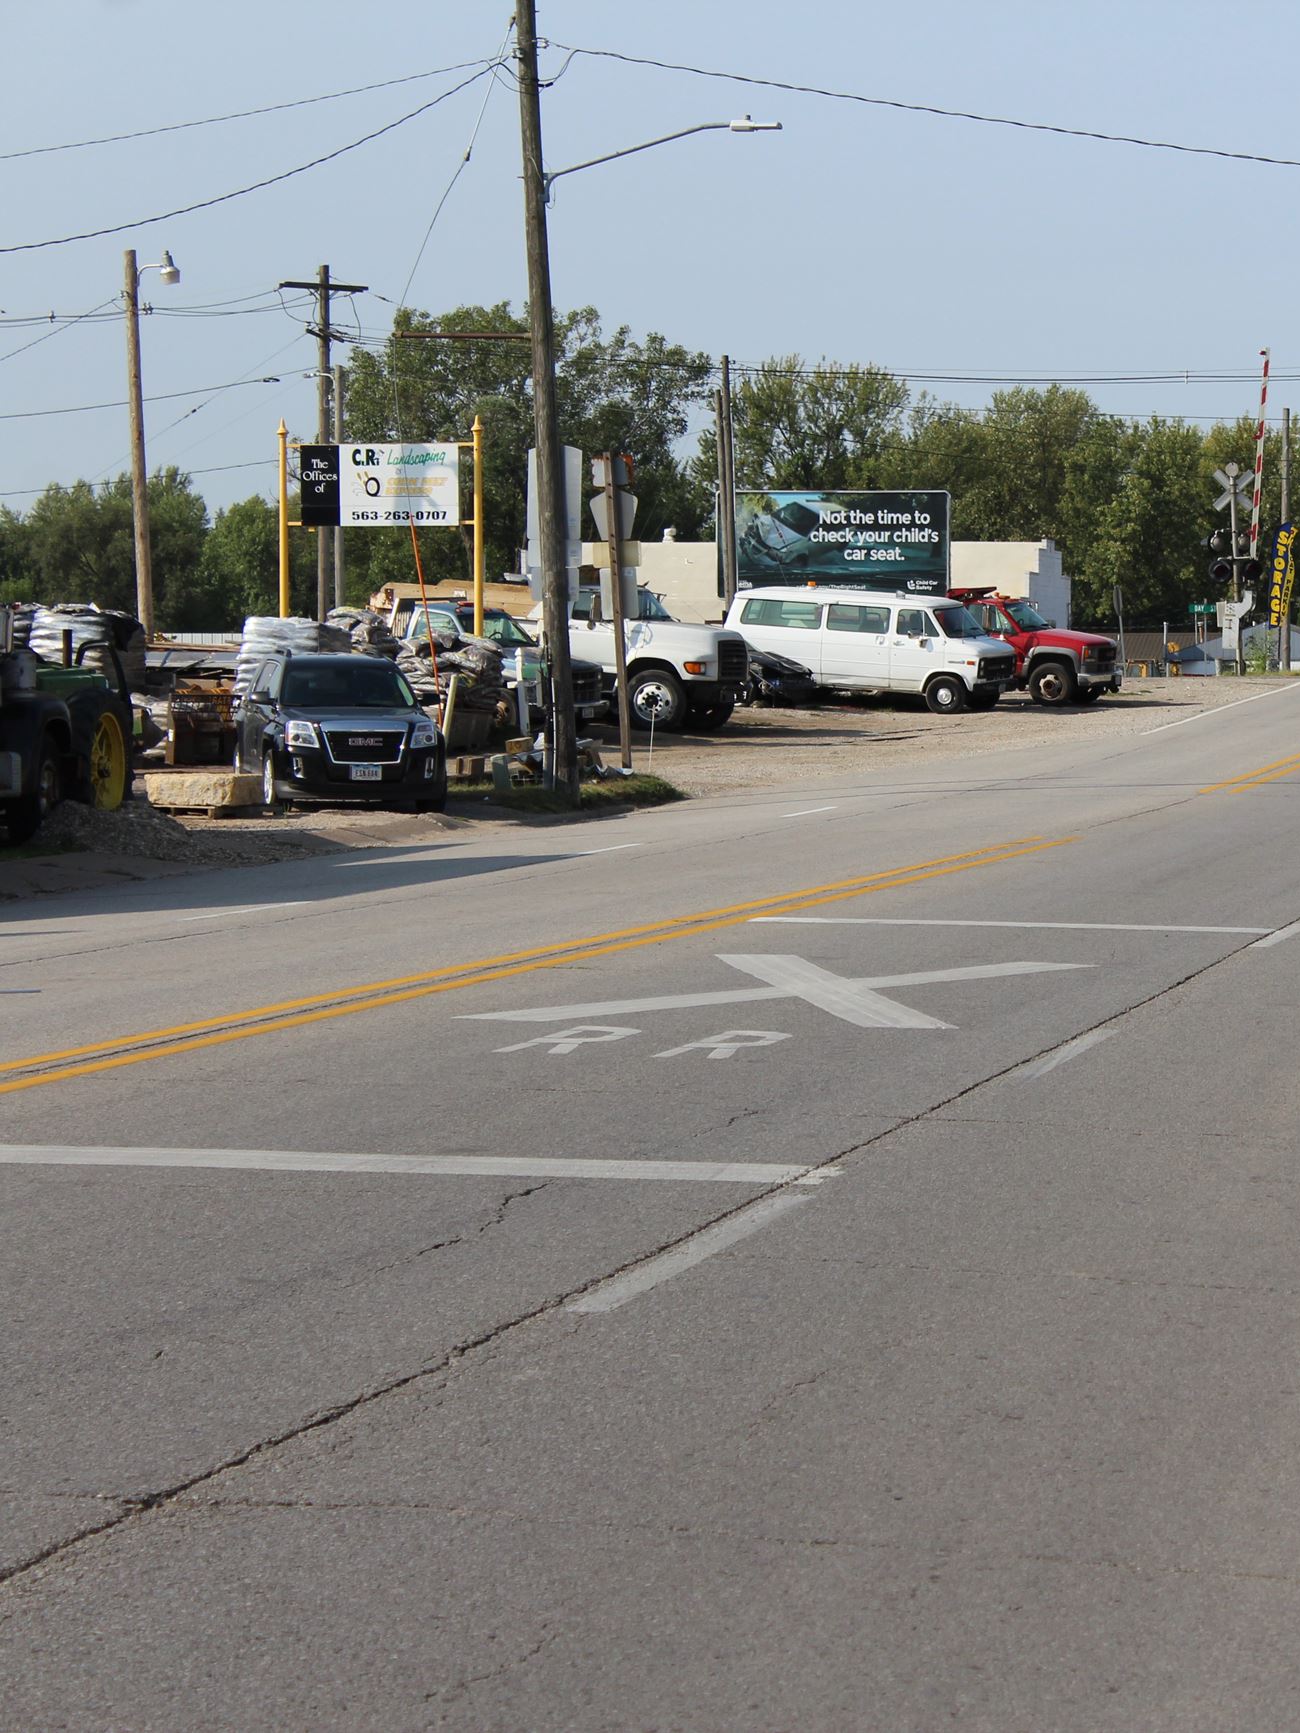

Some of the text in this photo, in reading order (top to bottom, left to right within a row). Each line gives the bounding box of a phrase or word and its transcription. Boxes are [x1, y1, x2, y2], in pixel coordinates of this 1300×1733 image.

[387, 448, 446, 466] Landscaping
[311, 459, 328, 469] The
[303, 471, 338, 481] Offices
[314, 483, 326, 493] of
[352, 511, 447, 521] 563-263-0707
[818, 510, 931, 525] Not the time to
[810, 528, 939, 545] check your child's
[843, 547, 905, 561] car seat.
[1270, 530, 1289, 626] STORAGE
[348, 737, 383, 746] GMC
